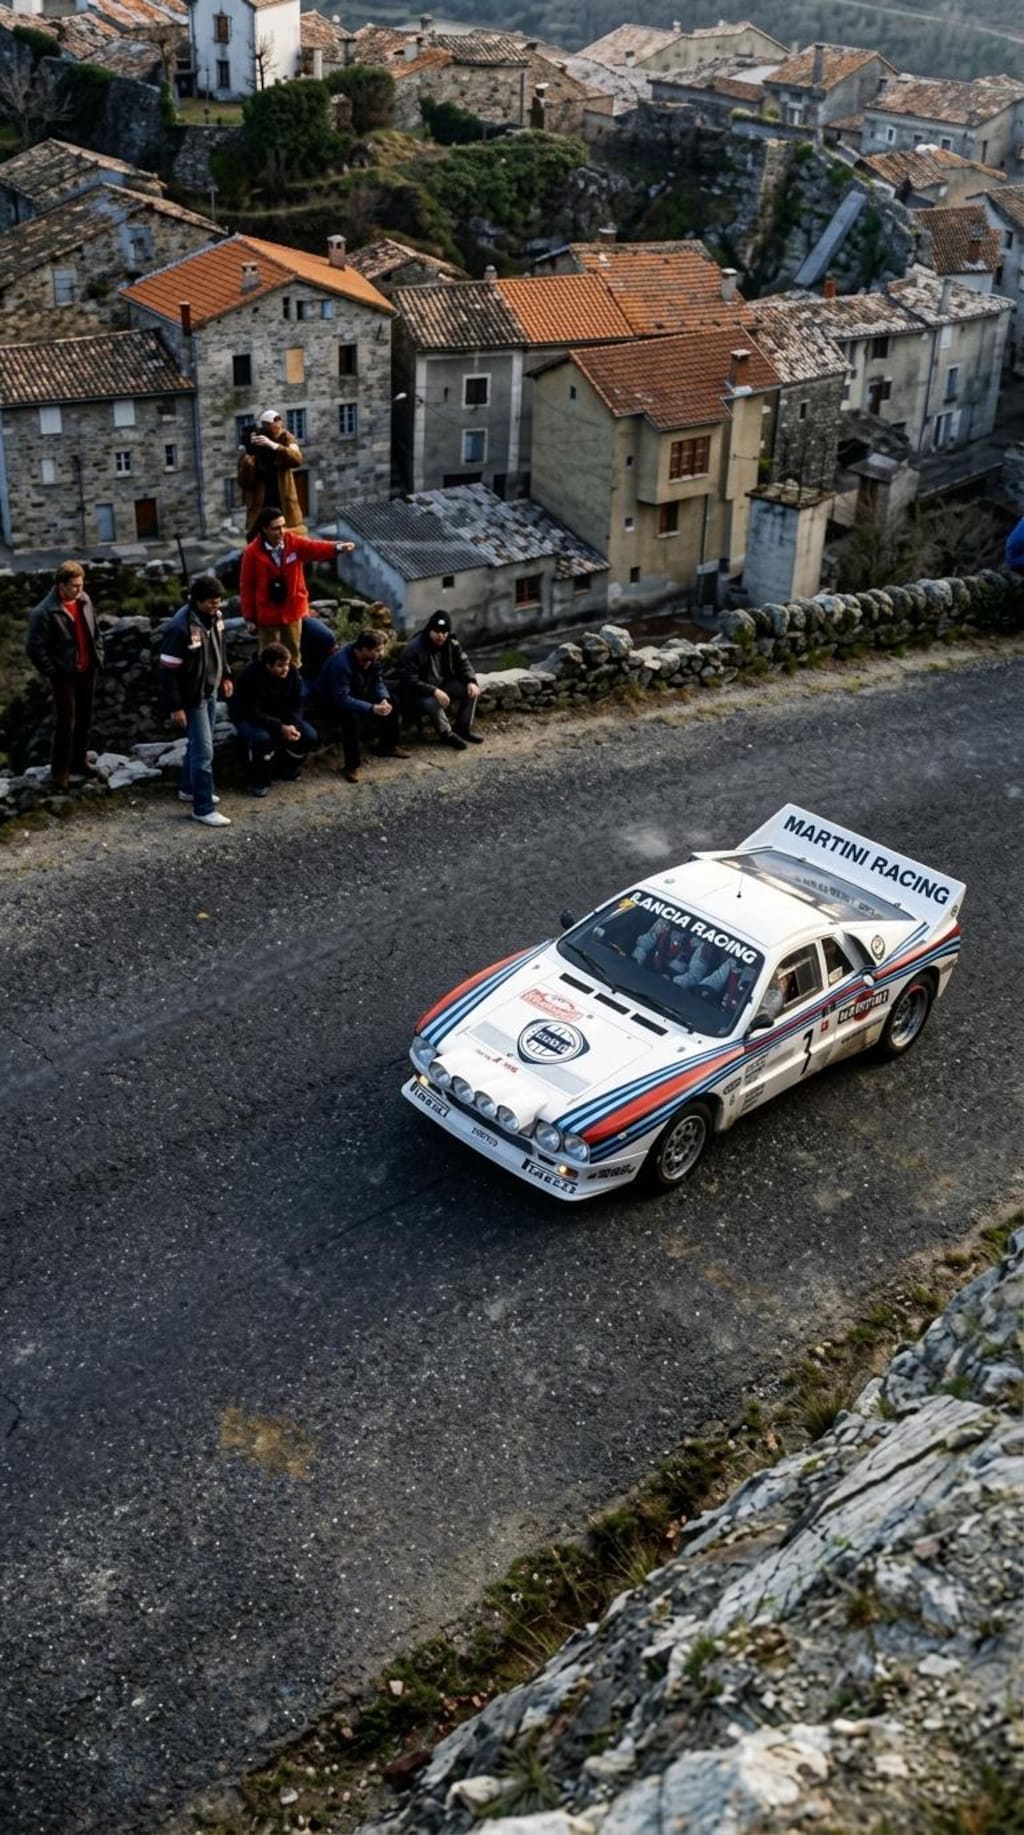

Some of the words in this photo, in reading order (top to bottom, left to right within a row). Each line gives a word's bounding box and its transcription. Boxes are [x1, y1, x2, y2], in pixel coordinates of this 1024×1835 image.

[784, 815, 870, 866] MARTINI
[870, 856, 950, 905] RACING
[630, 892, 691, 928] LANCIA
[691, 922, 758, 965] RACING
